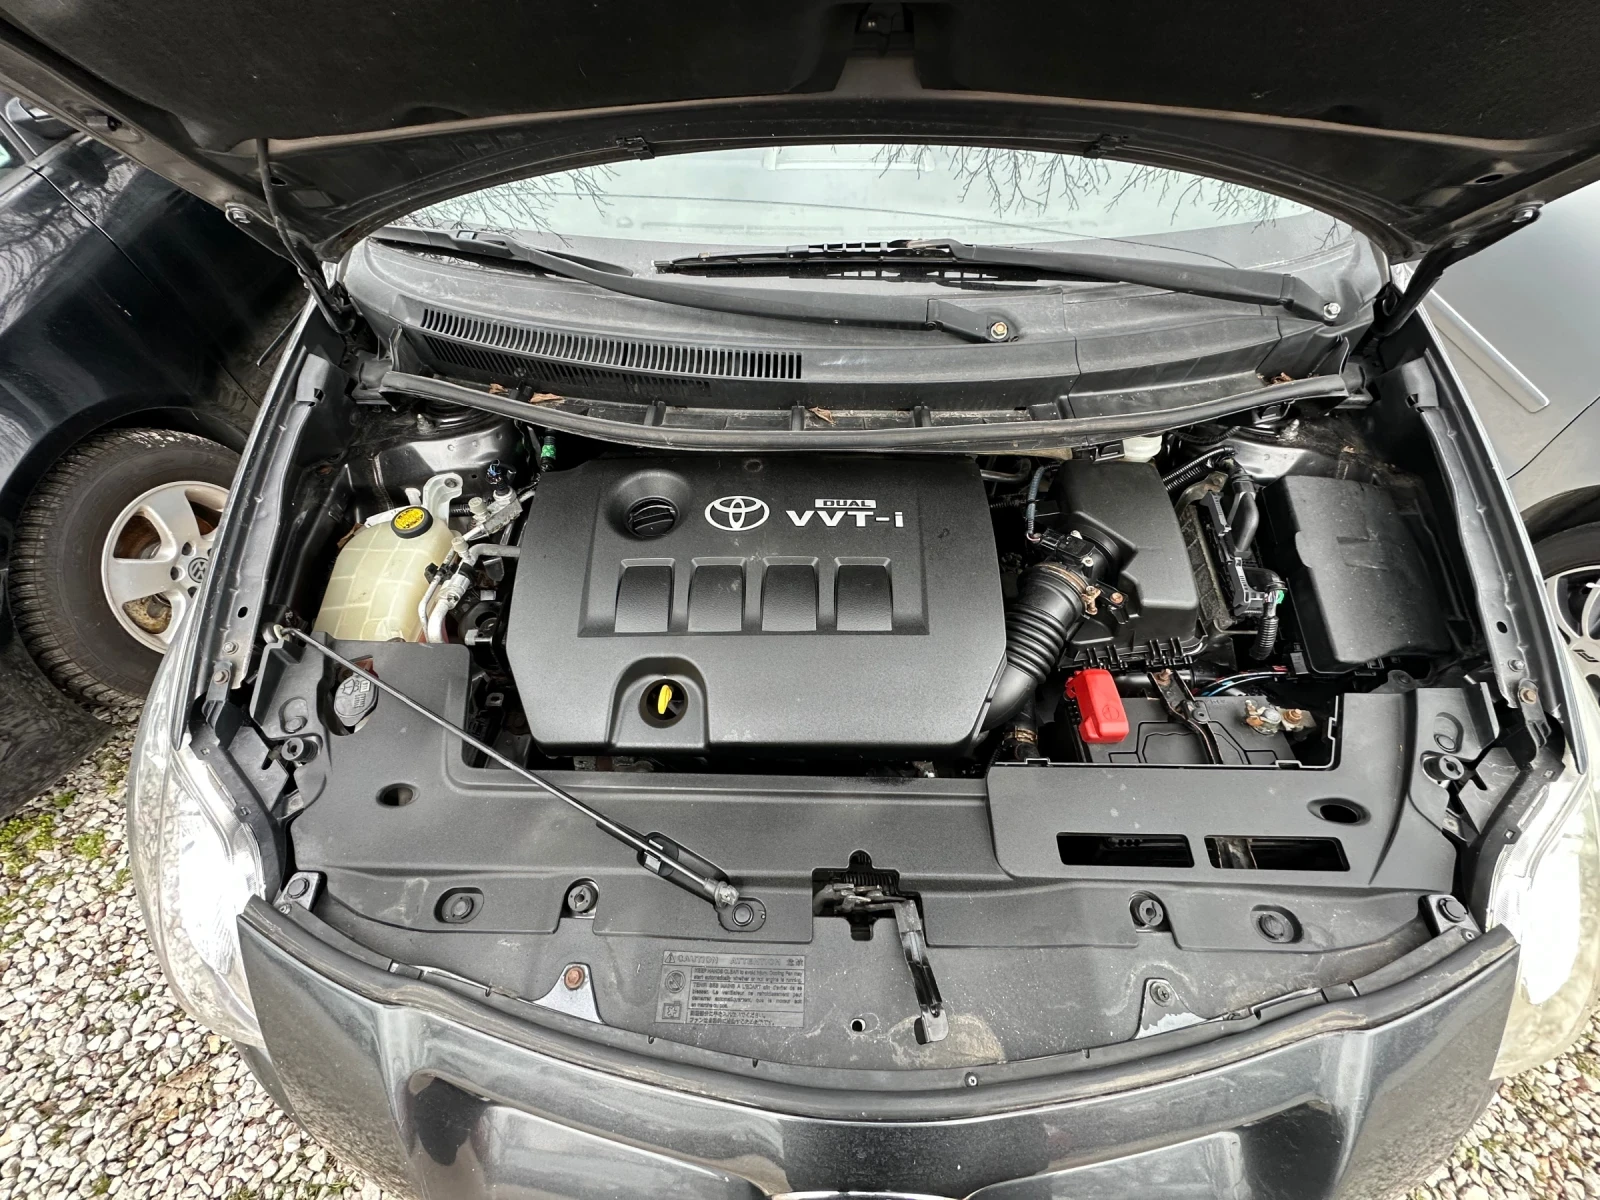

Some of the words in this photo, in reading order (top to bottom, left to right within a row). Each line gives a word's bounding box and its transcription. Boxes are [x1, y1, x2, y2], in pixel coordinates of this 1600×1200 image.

[821, 500, 872, 508] DUAL
[785, 510, 904, 527] VVT-i
[678, 955, 719, 965] CAUTION
[729, 957, 781, 966] ATTENTION
